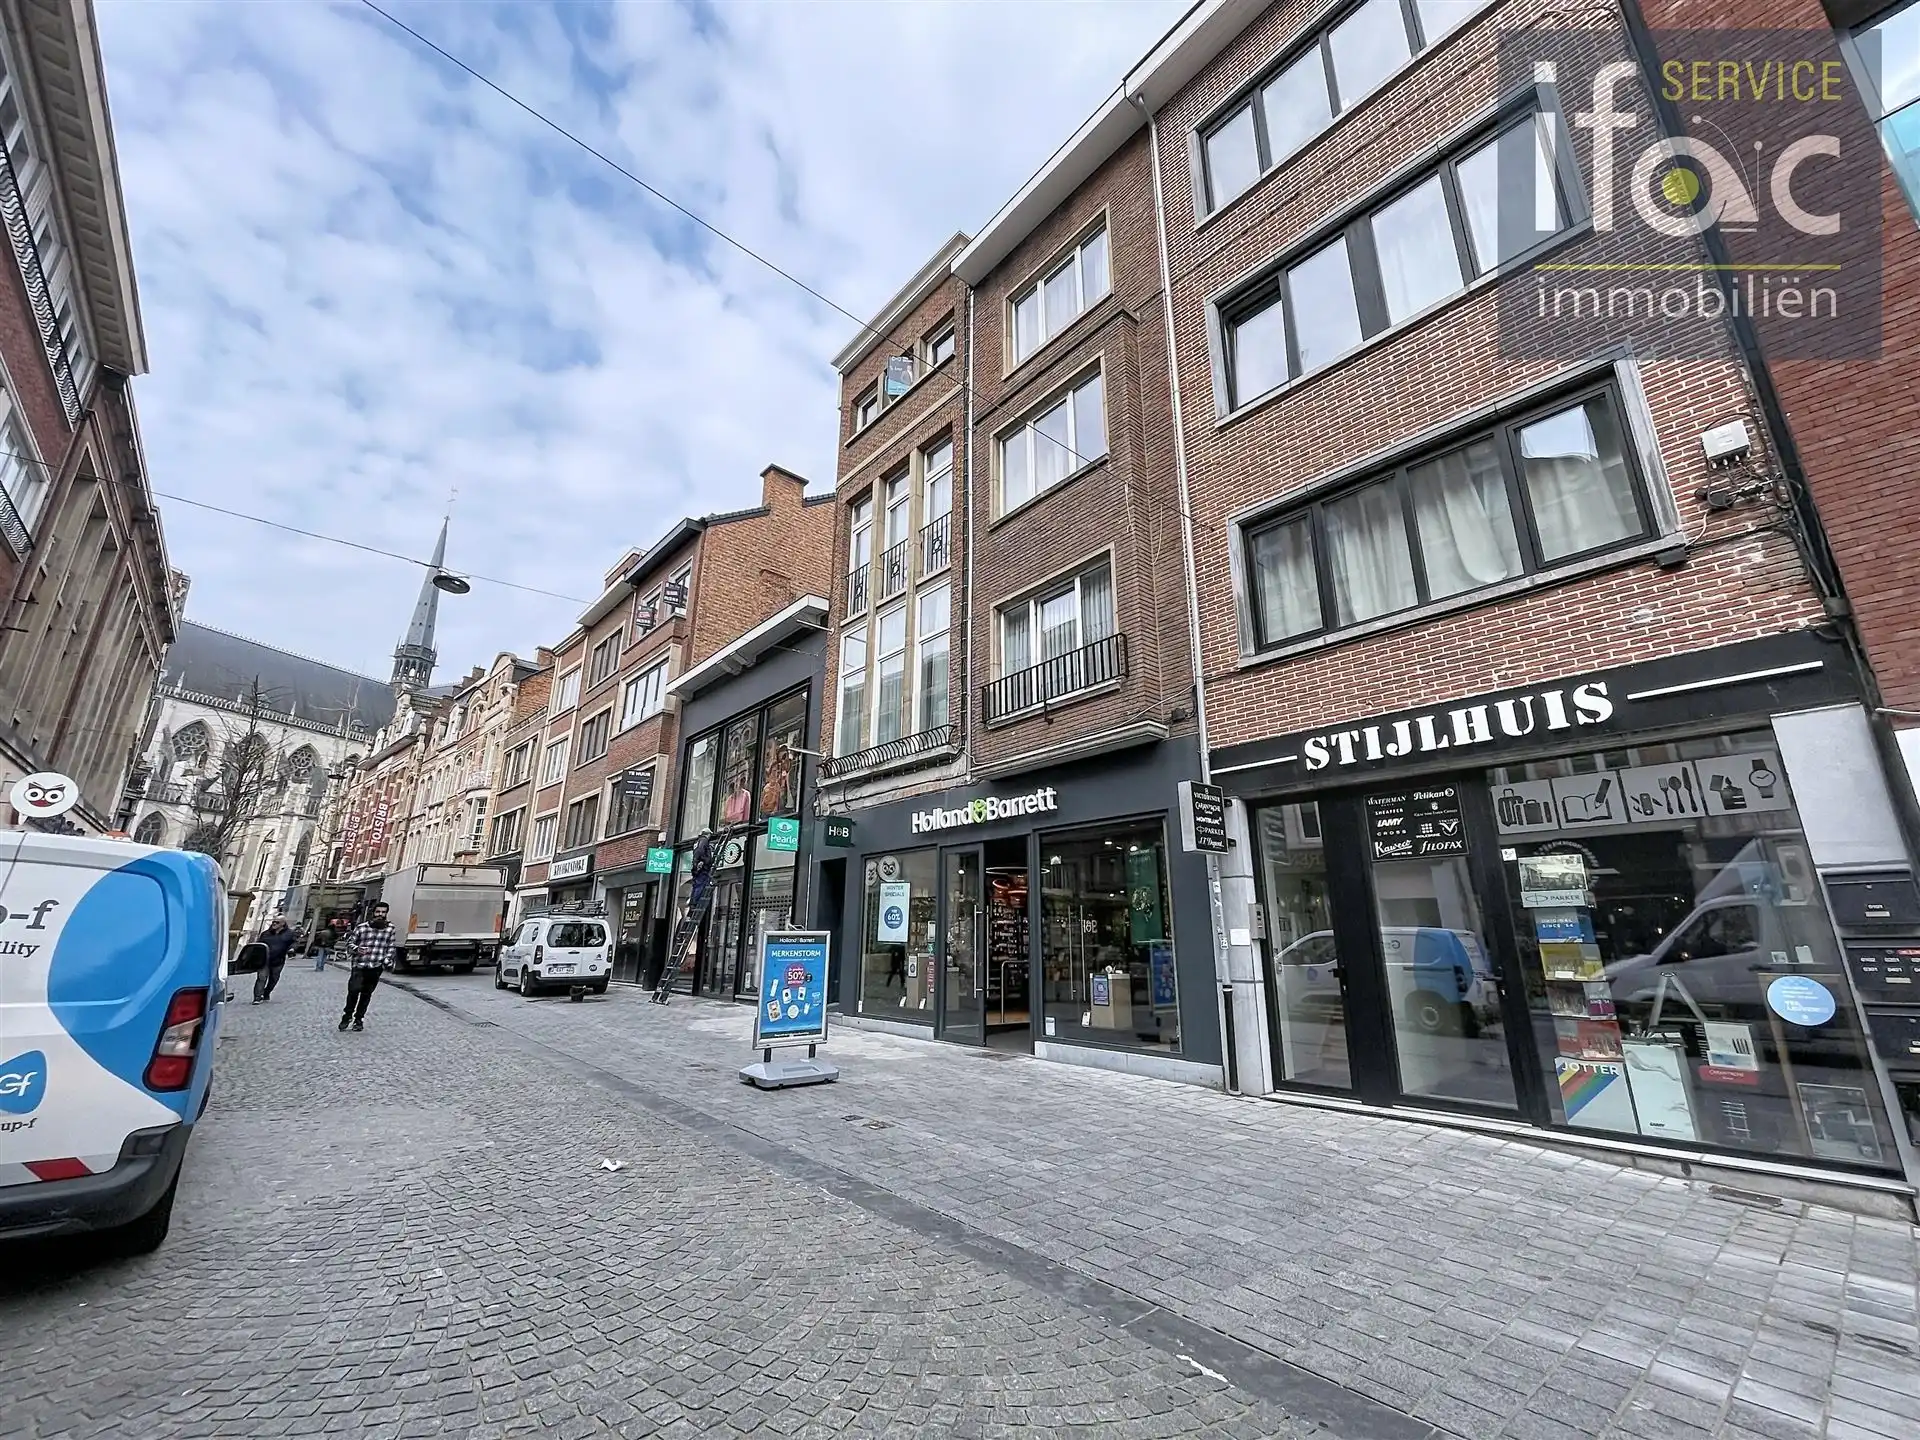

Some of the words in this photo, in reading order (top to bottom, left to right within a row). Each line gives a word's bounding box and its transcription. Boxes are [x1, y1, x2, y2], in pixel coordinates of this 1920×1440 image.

[1303, 681, 1614, 771] STIJLHUIS
[1367, 795, 1407, 806] WATERMAN
[1413, 791, 1444, 801] Pelikan
[370, 802, 389, 846] BRISTOL
[1377, 817, 1404, 828] LAMY
[770, 833, 798, 844] Pearle
[1376, 829, 1407, 837] CROSS
[1374, 840, 1413, 858] Kaweco
[648, 859, 672, 869] Pearle
[0, 899, 60, 930] -f
[771, 949, 821, 958] MERKENSTORM
[787, 971, 805, 980] 50%
[1561, 1061, 1620, 1076] JOTTER
